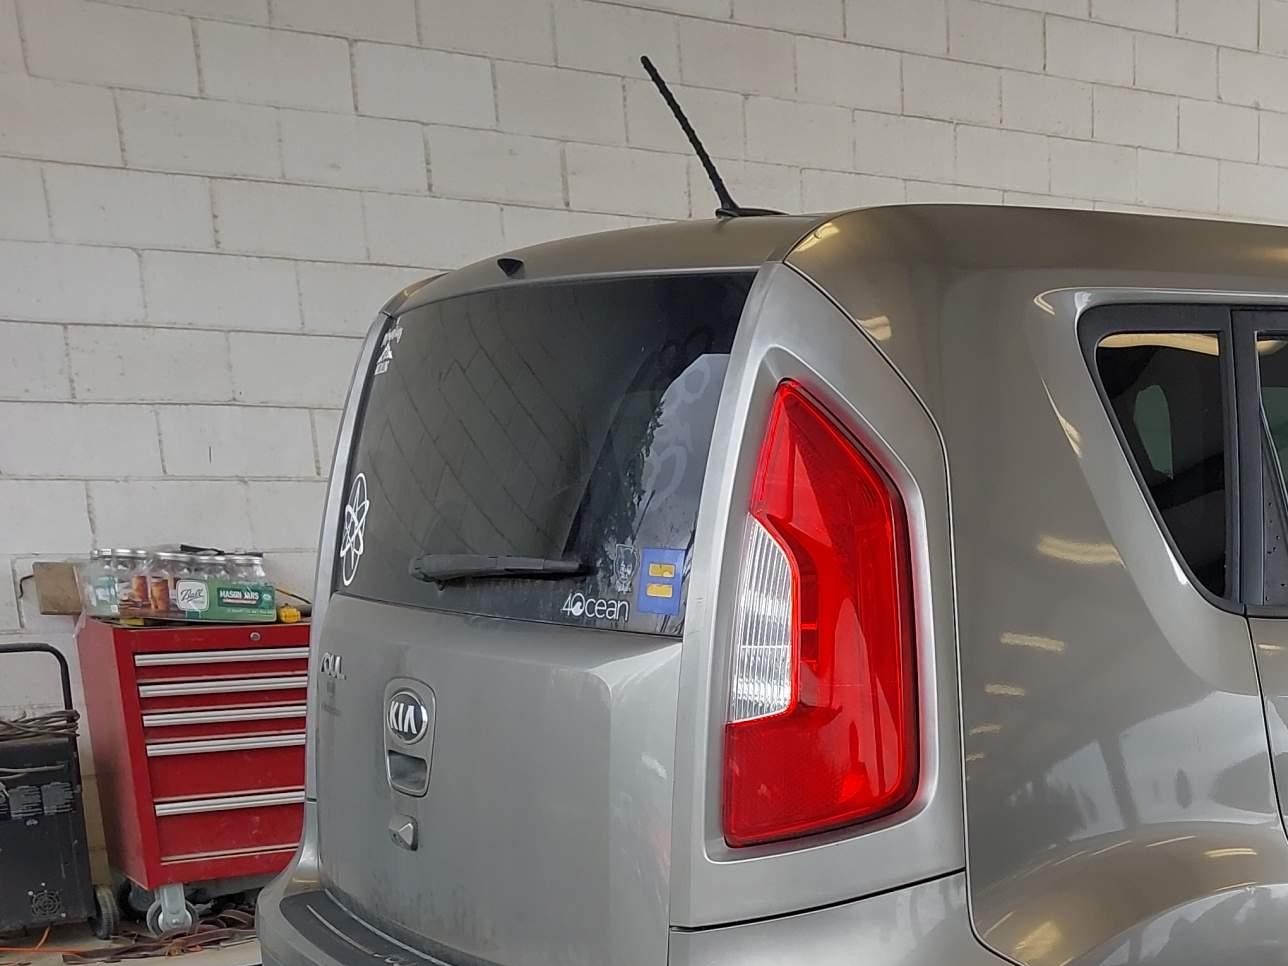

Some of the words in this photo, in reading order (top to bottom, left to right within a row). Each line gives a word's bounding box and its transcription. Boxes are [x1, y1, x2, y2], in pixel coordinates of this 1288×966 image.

[180, 588, 204, 602] Ball
[219, 590, 242, 600] MASON
[389, 700, 418, 735] KIA
